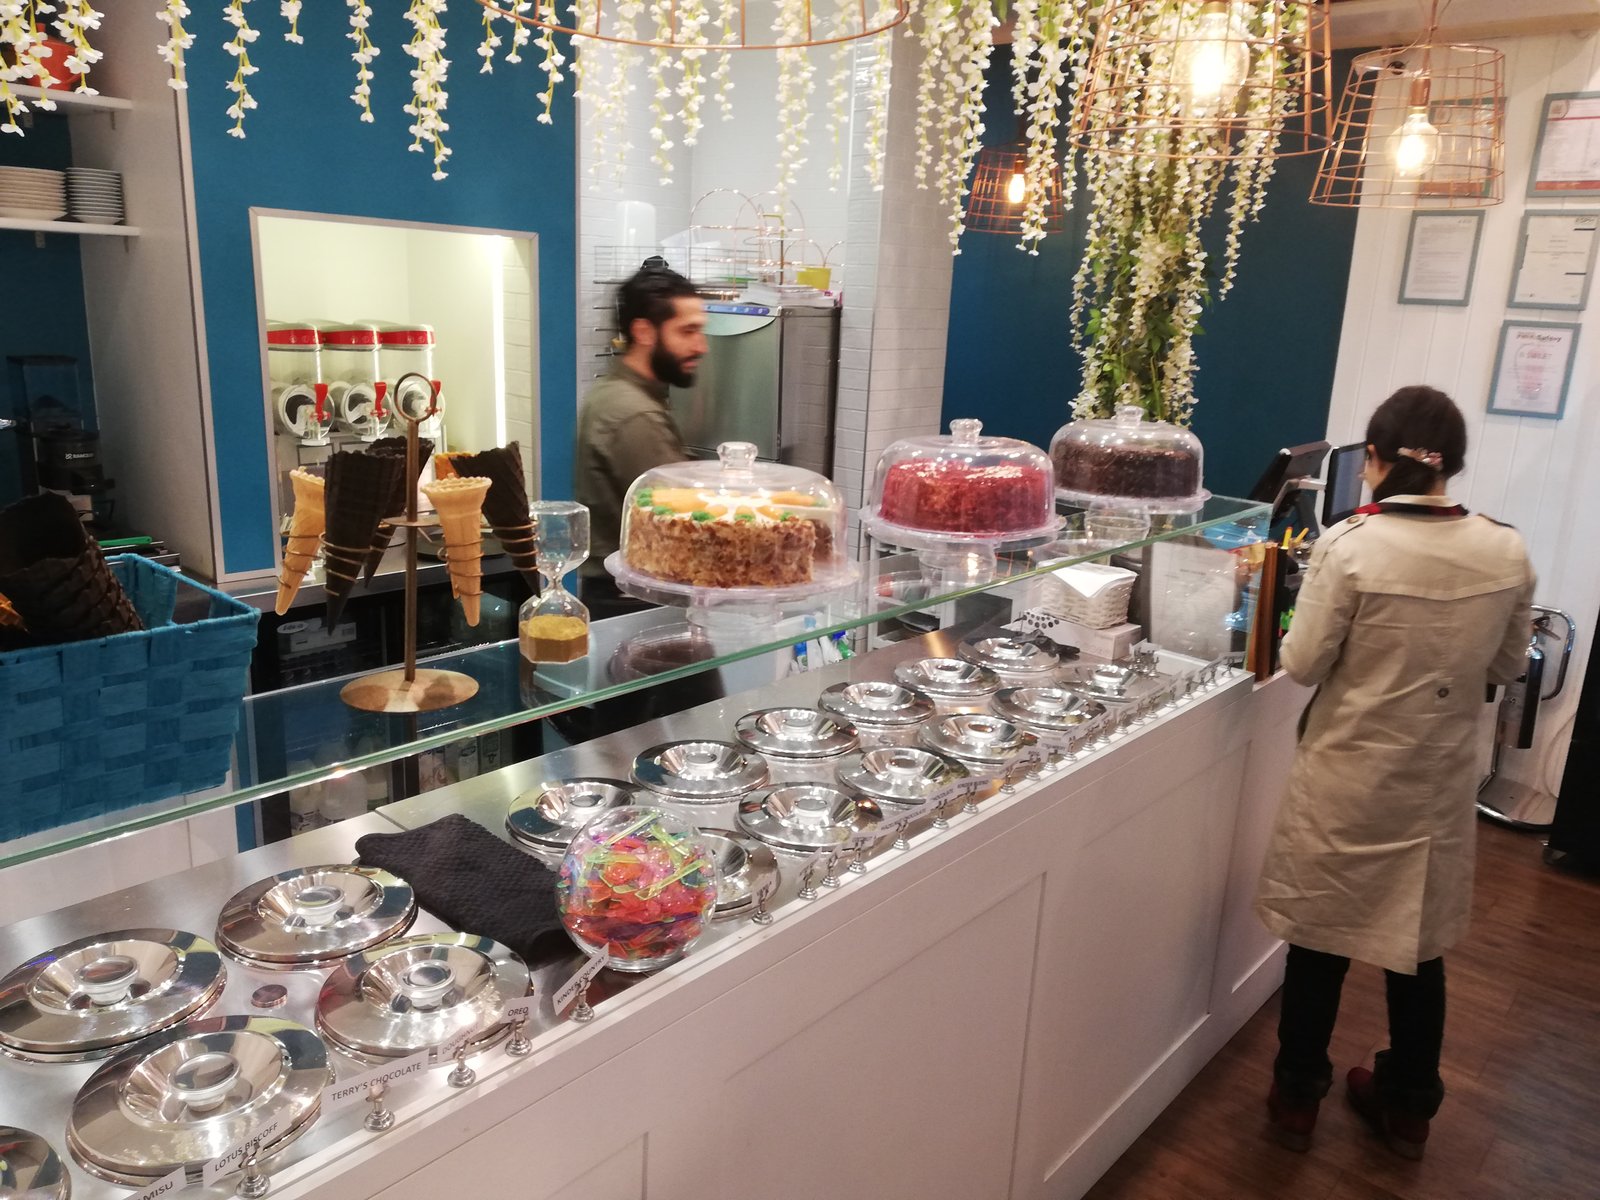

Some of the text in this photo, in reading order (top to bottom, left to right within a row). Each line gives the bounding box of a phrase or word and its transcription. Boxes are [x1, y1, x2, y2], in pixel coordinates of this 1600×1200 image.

[507, 1006, 529, 1017] OREO
[331, 1062, 422, 1101] TERRY'S CHOCOLATE
[214, 1122, 279, 1172] LOTUS BISCOFF
[138, 1181, 174, 1200] MISU
